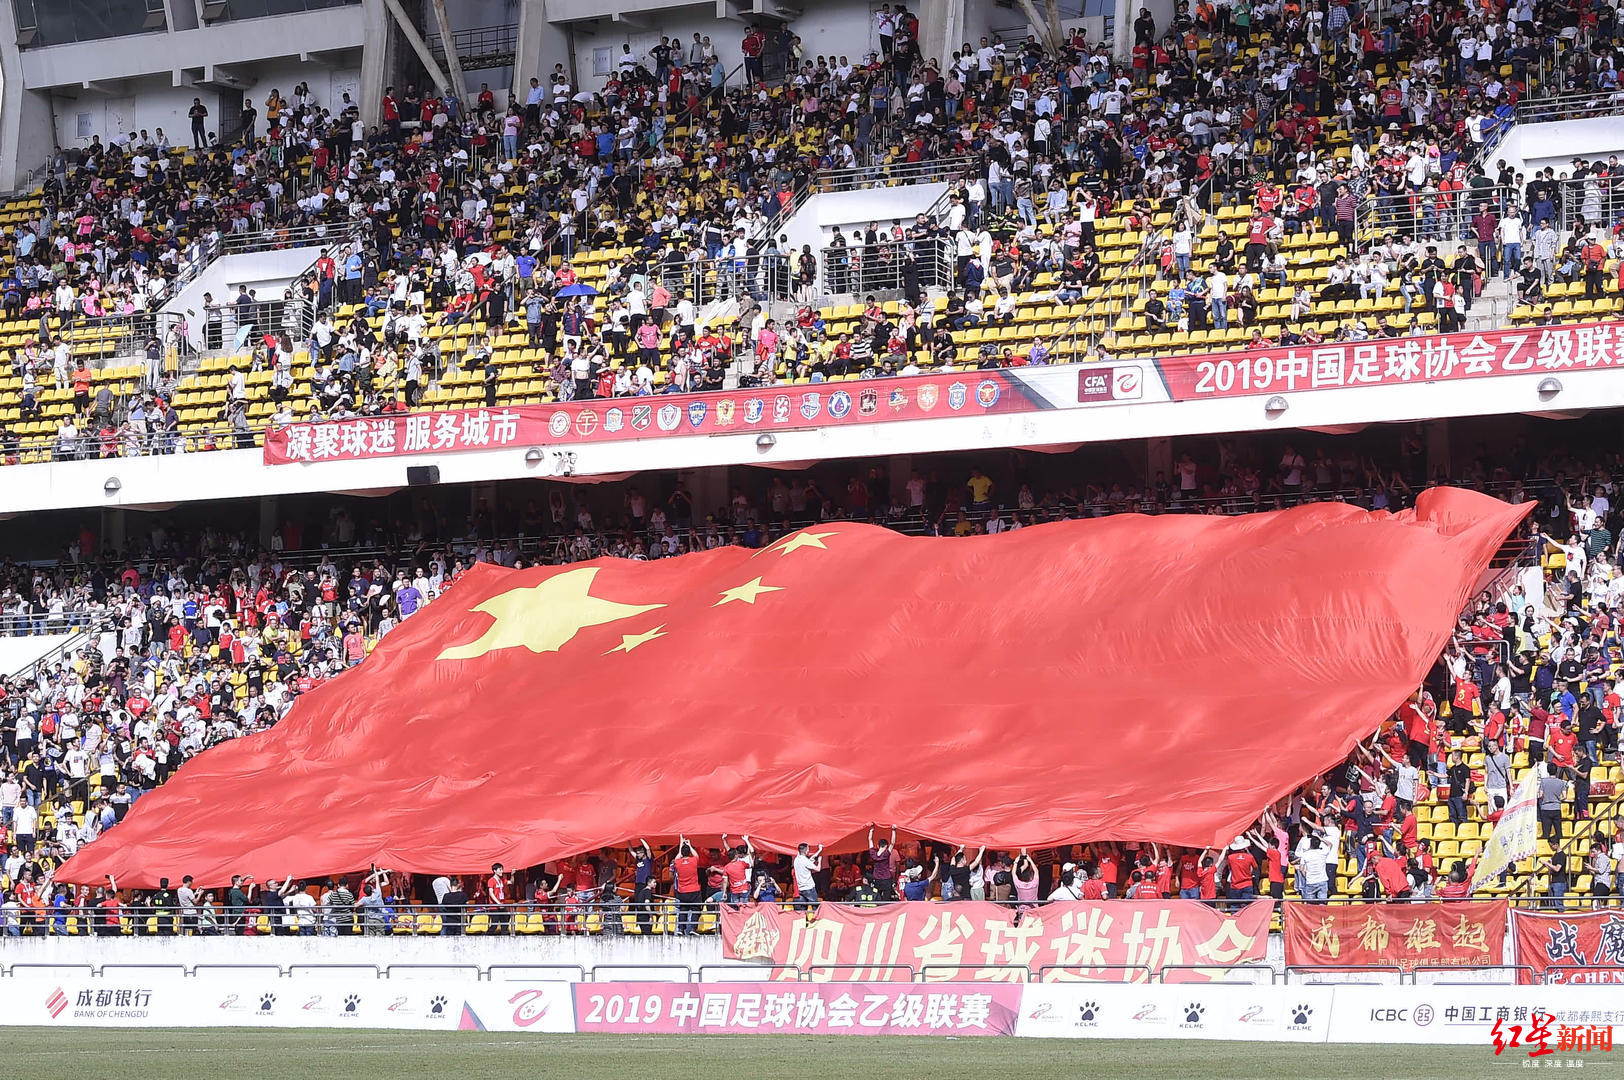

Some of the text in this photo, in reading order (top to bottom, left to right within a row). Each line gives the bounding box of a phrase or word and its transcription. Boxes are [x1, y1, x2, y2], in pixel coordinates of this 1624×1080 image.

[1194, 325, 1624, 393] 2019中国足球协会乙级联
[1084, 375, 1106, 388] CFA
[285, 409, 521, 459] 凝聚球迷 服务城市
[1310, 913, 1491, 959] 成都雄起
[76, 989, 153, 1007] 成都银行
[584, 992, 992, 1029] 2019 中国足球协会乙级联赛
[74, 1010, 149, 1018] BANK OF CHENGDU
[1370, 1008, 1408, 1022] ICBC
[1444, 1005, 1546, 1022] 中国工商银行
